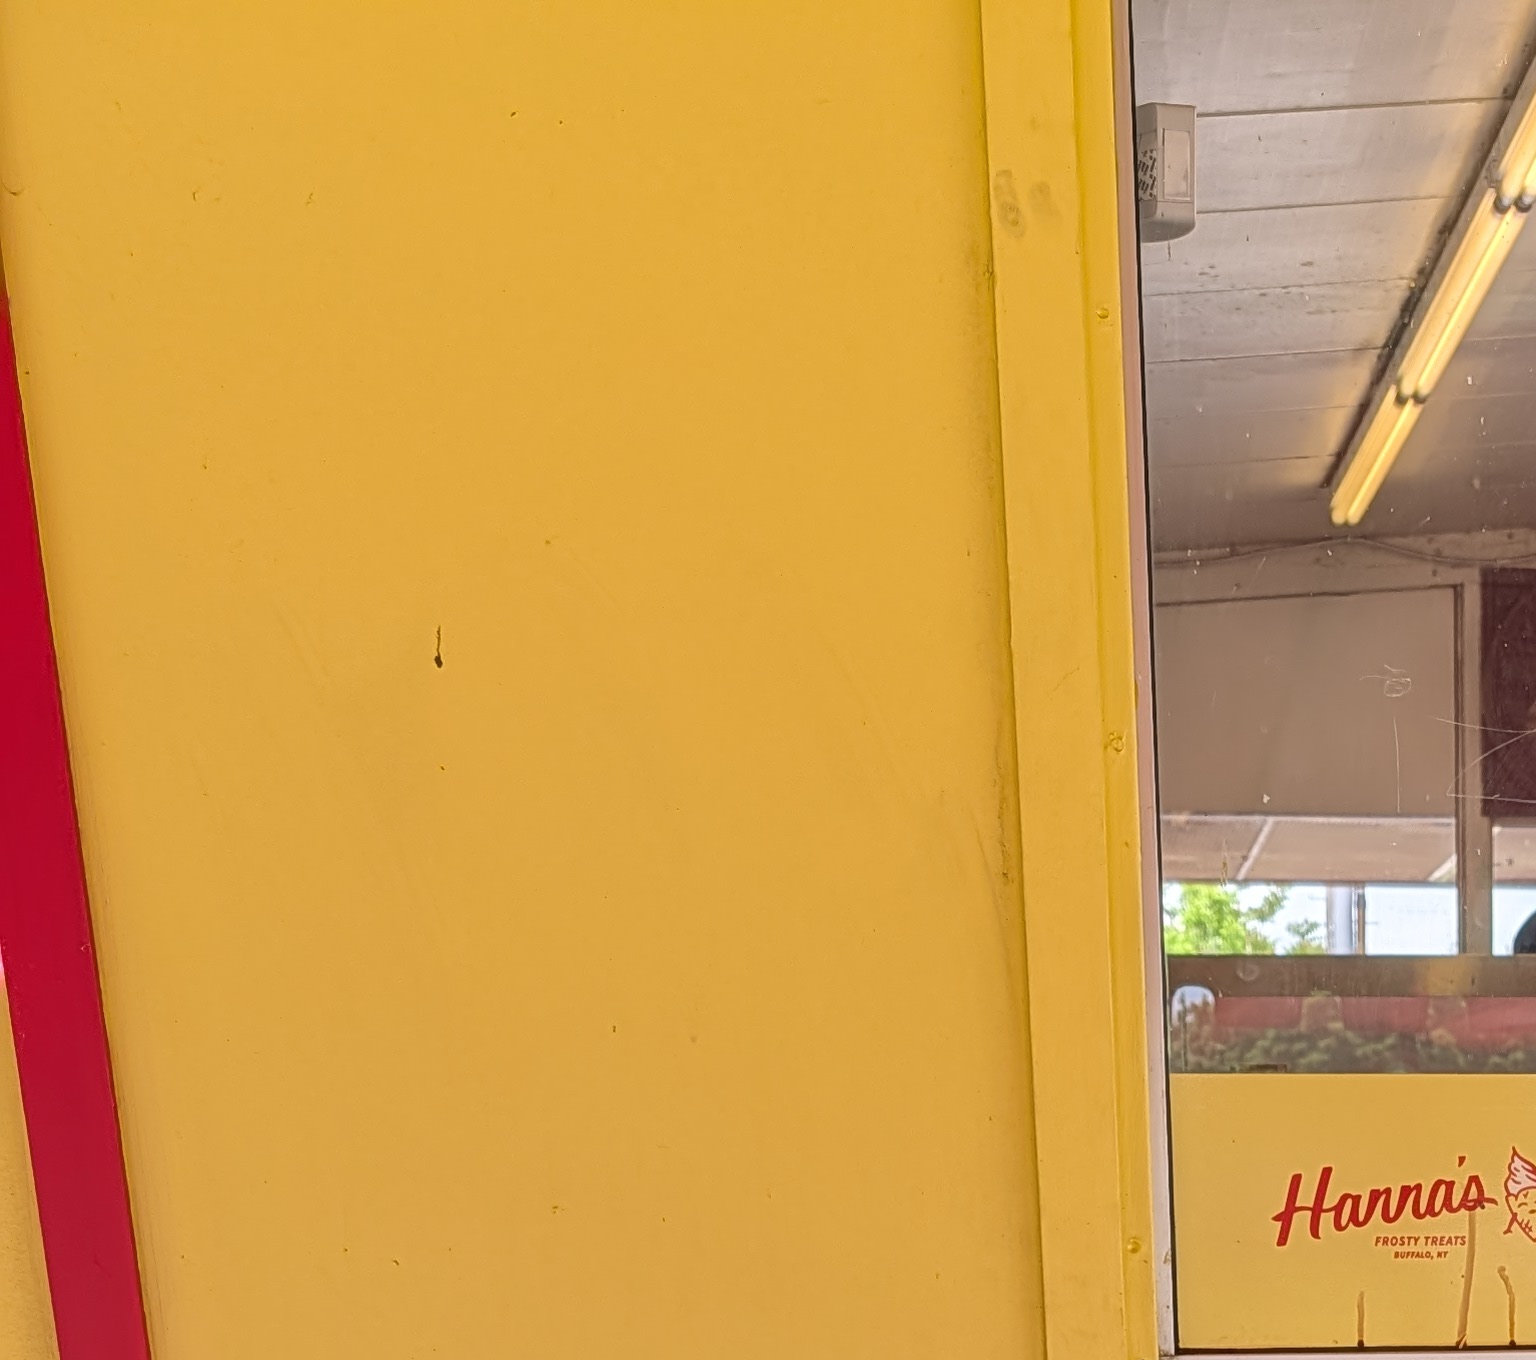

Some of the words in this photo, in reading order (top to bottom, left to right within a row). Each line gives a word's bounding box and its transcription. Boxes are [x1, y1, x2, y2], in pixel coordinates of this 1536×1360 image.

[1271, 1155, 1498, 1247] Hanna's
[1374, 1235, 1420, 1247] FROSTY
[1423, 1235, 1467, 1247] TREATS
[1393, 1251, 1434, 1260] BUFFALO,
[1436, 1250, 1449, 1259] NY
